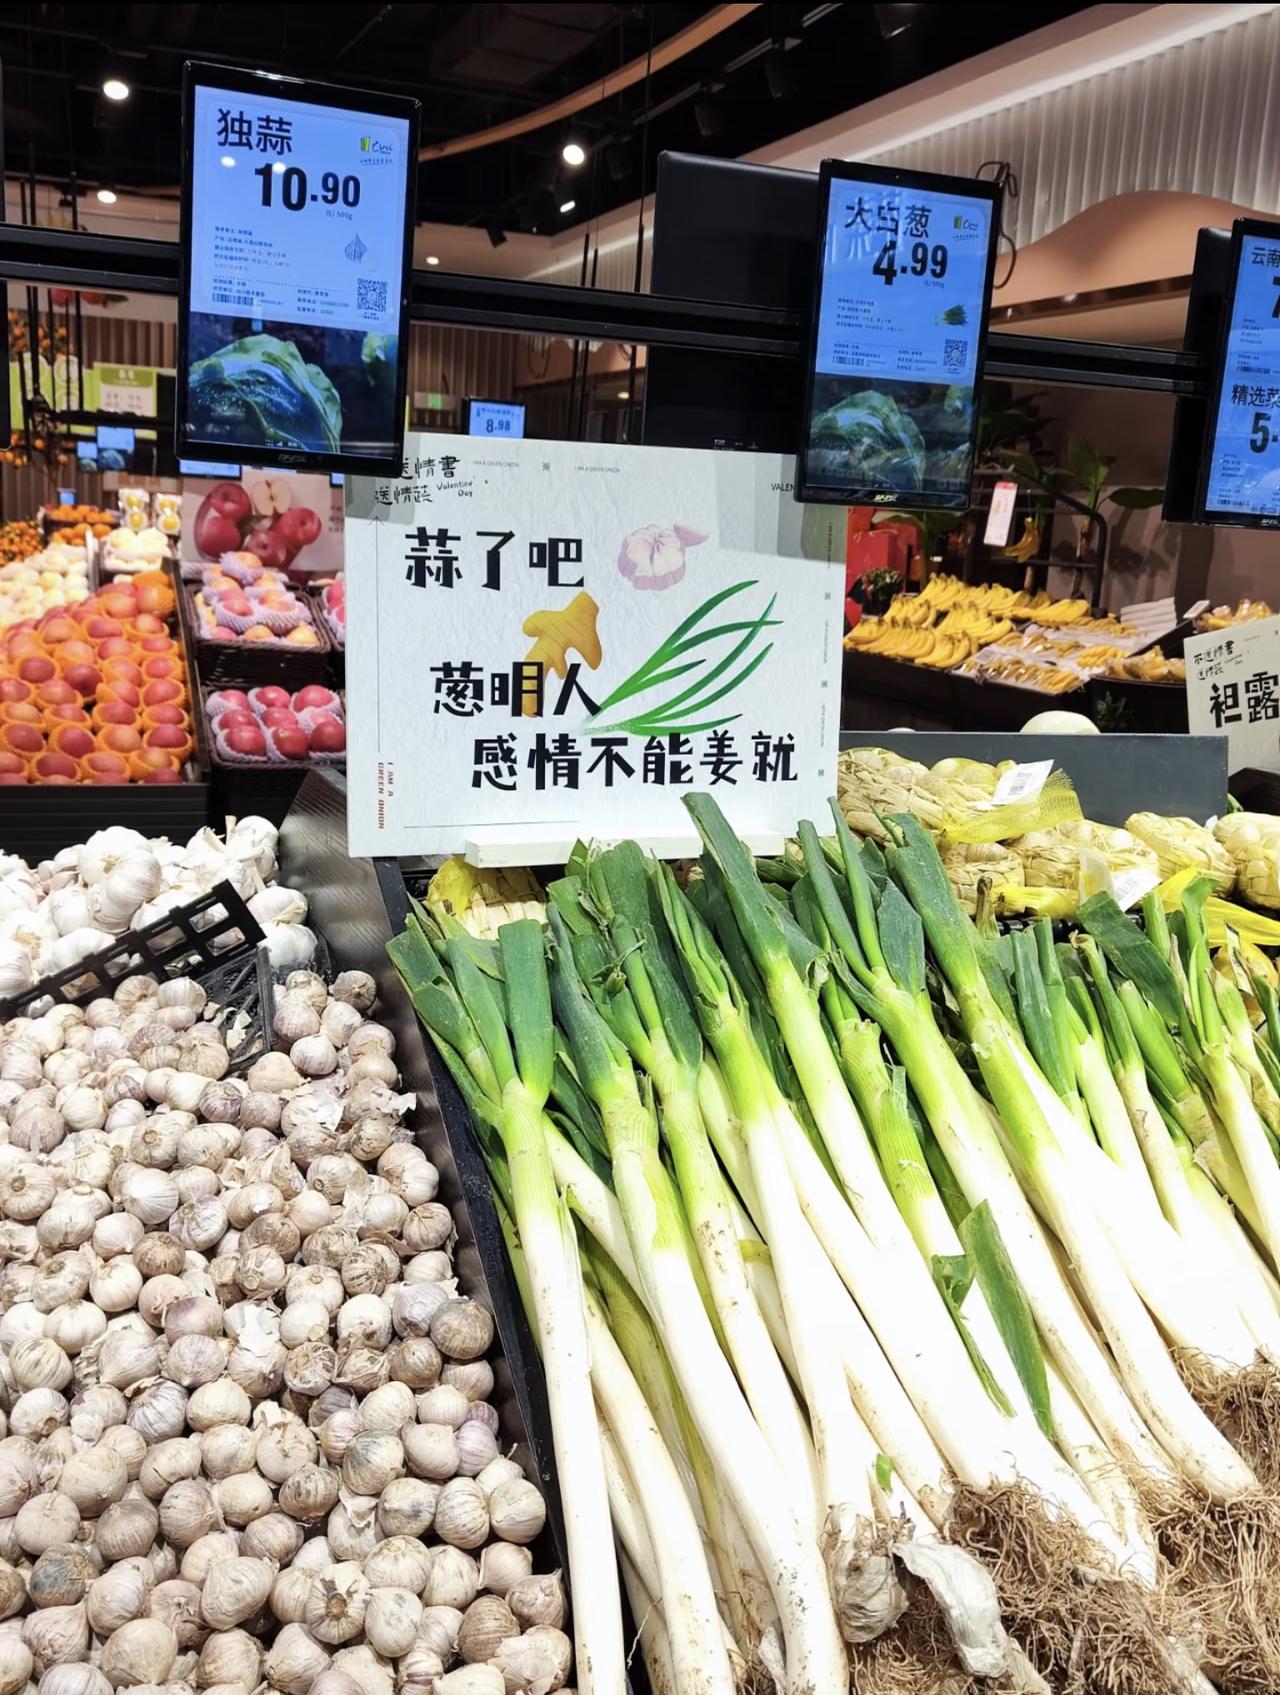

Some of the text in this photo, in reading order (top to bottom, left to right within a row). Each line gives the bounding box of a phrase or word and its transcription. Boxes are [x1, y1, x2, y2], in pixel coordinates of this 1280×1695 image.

[217, 108, 293, 155] 独蒜
[254, 163, 361, 211] 10.90
[872, 240, 948, 286] 4.99
[486, 418, 510, 433] 8.98
[404, 526, 585, 591] 蒜了吧
[430, 661, 603, 718] 葱明人
[1210, 671, 1280, 728] 袒露
[471, 729, 798, 792] 感情不能姜就
